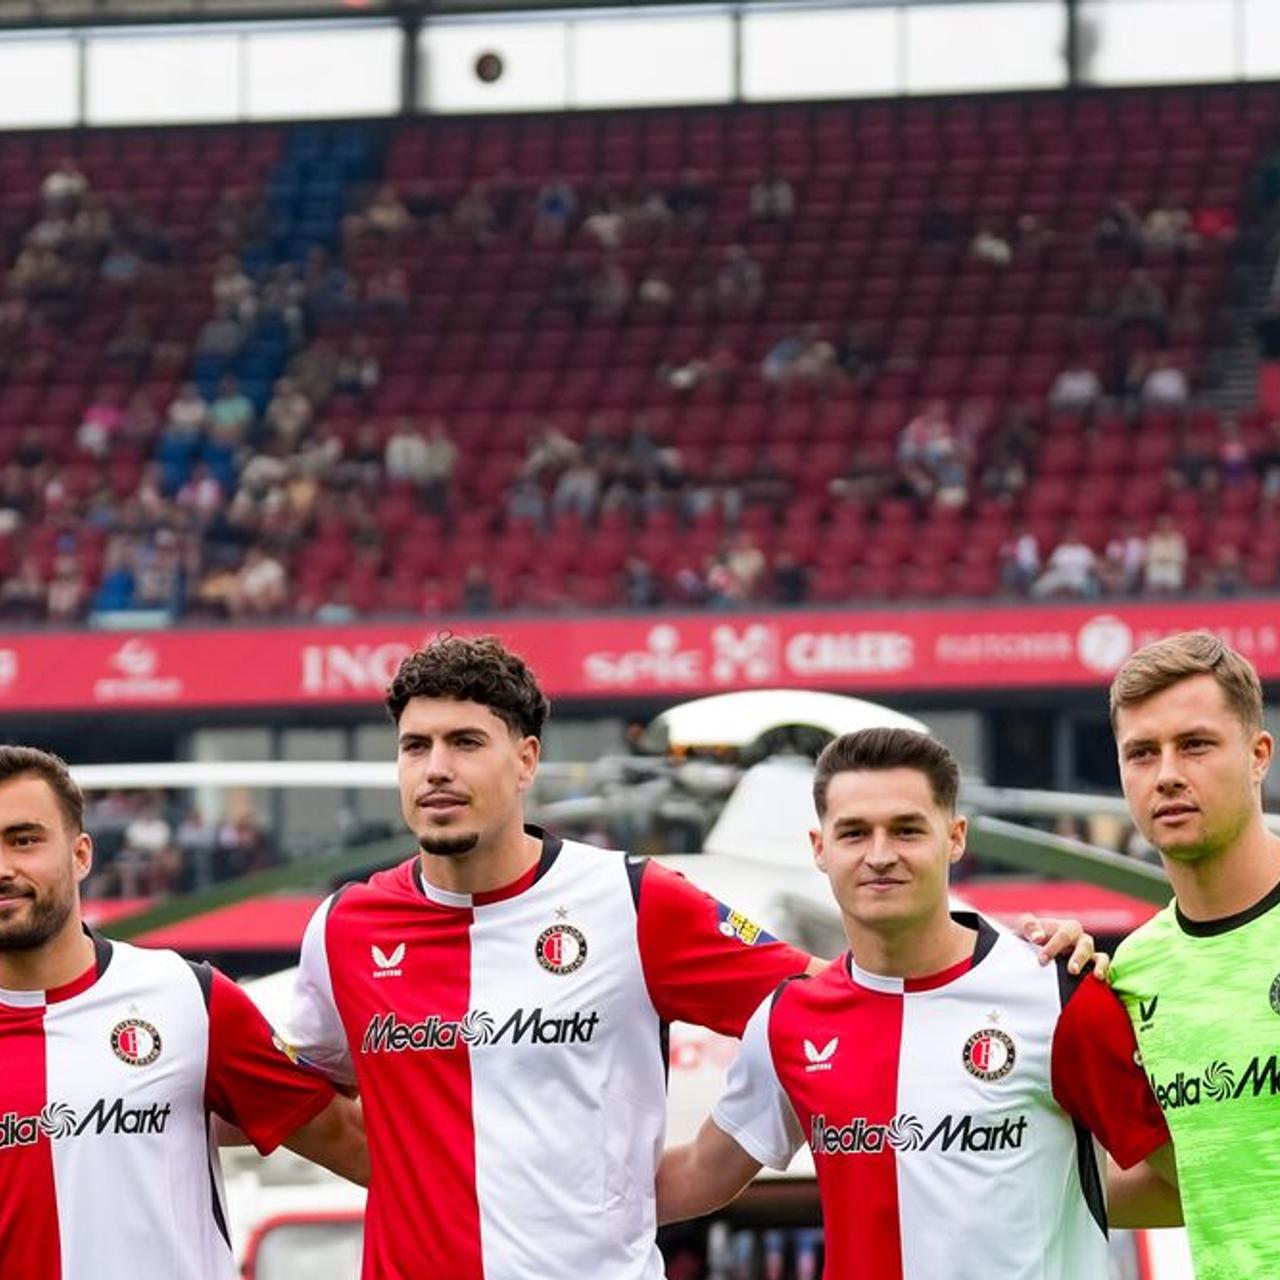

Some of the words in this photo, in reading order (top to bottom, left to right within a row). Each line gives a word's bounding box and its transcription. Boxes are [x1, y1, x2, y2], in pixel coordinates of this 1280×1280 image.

[361, 1013, 459, 1053] Media
[490, 1008, 599, 1046] Markt
[1151, 1071, 1201, 1111] edia
[74, 1098, 171, 1136] Markt
[921, 1114, 1028, 1152] Markt
